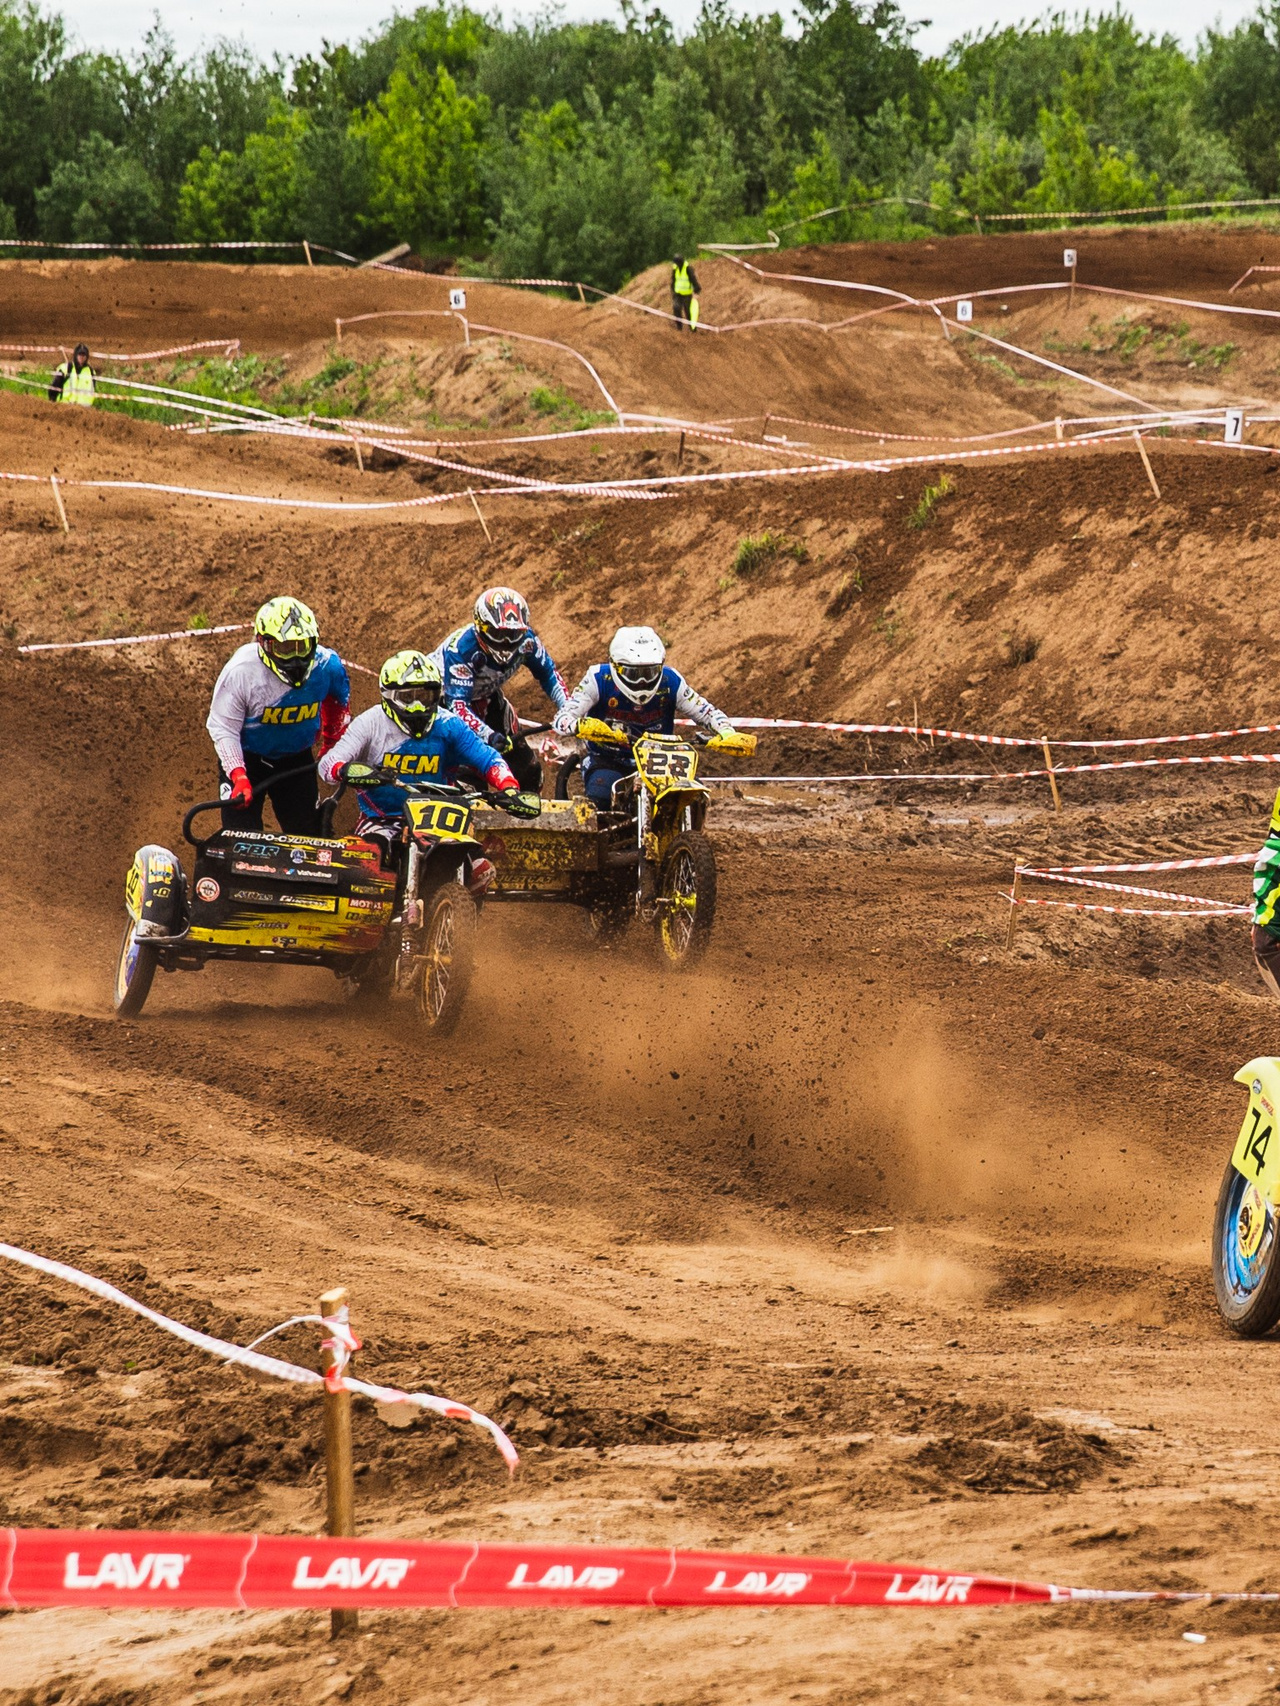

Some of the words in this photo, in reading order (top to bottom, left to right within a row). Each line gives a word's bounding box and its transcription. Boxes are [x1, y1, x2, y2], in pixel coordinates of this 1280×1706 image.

[961, 304, 968, 316] 6
[1232, 417, 1240, 436] 7
[415, 805, 464, 835] 10
[1243, 1107, 1273, 1177] 74
[63, 1552, 186, 1589] LAVR
[291, 1556, 412, 1590] LAVR
[884, 1574, 975, 1603] LAVR
